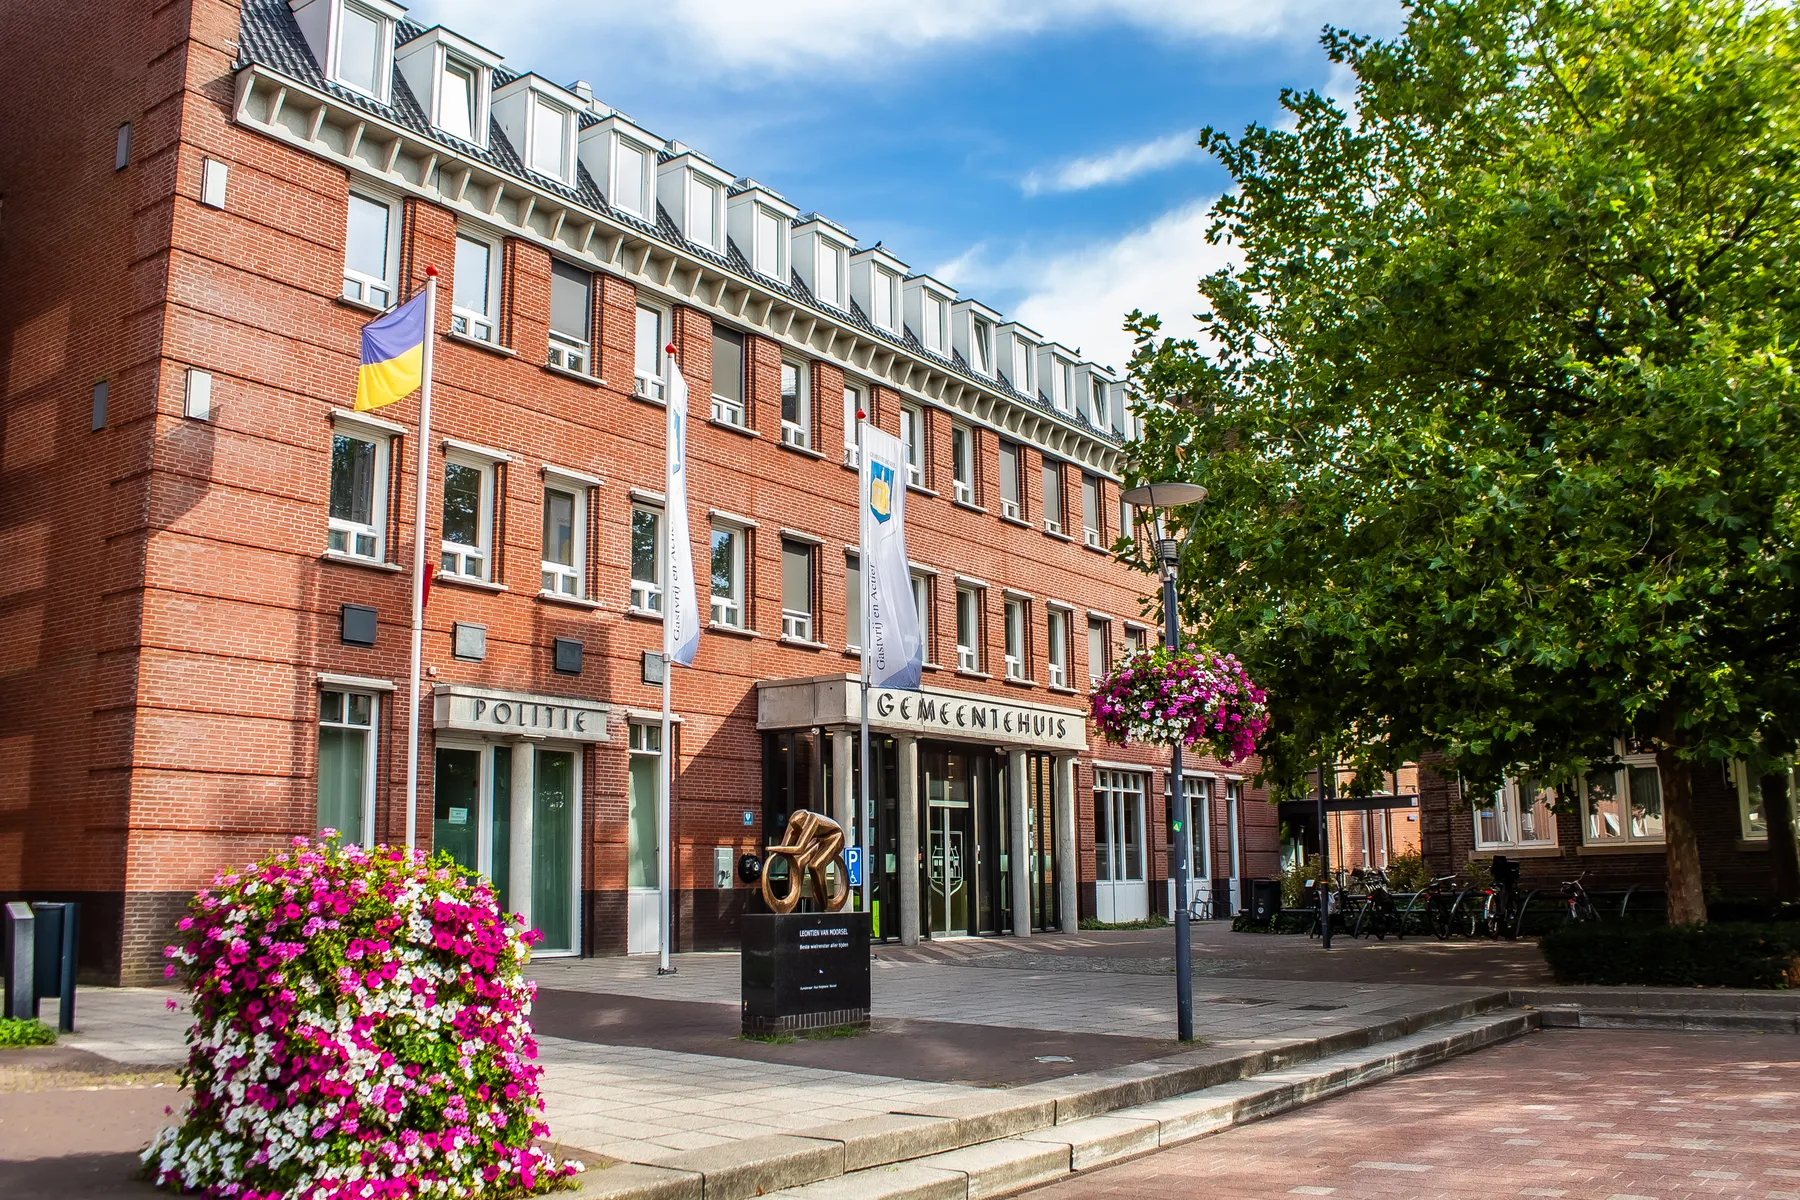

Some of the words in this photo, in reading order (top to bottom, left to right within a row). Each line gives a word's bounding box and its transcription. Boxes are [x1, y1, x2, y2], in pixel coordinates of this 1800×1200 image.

[672, 566, 679, 581] en
[870, 562, 879, 601] Actief
[672, 585, 681, 641] Gastvrij
[873, 604, 879, 618] en
[873, 622, 886, 670] Gastvrij
[474, 698, 587, 732] POLITIE
[876, 692, 1067, 739] GEMEENTEHUIS
[848, 850, 858, 870] P
